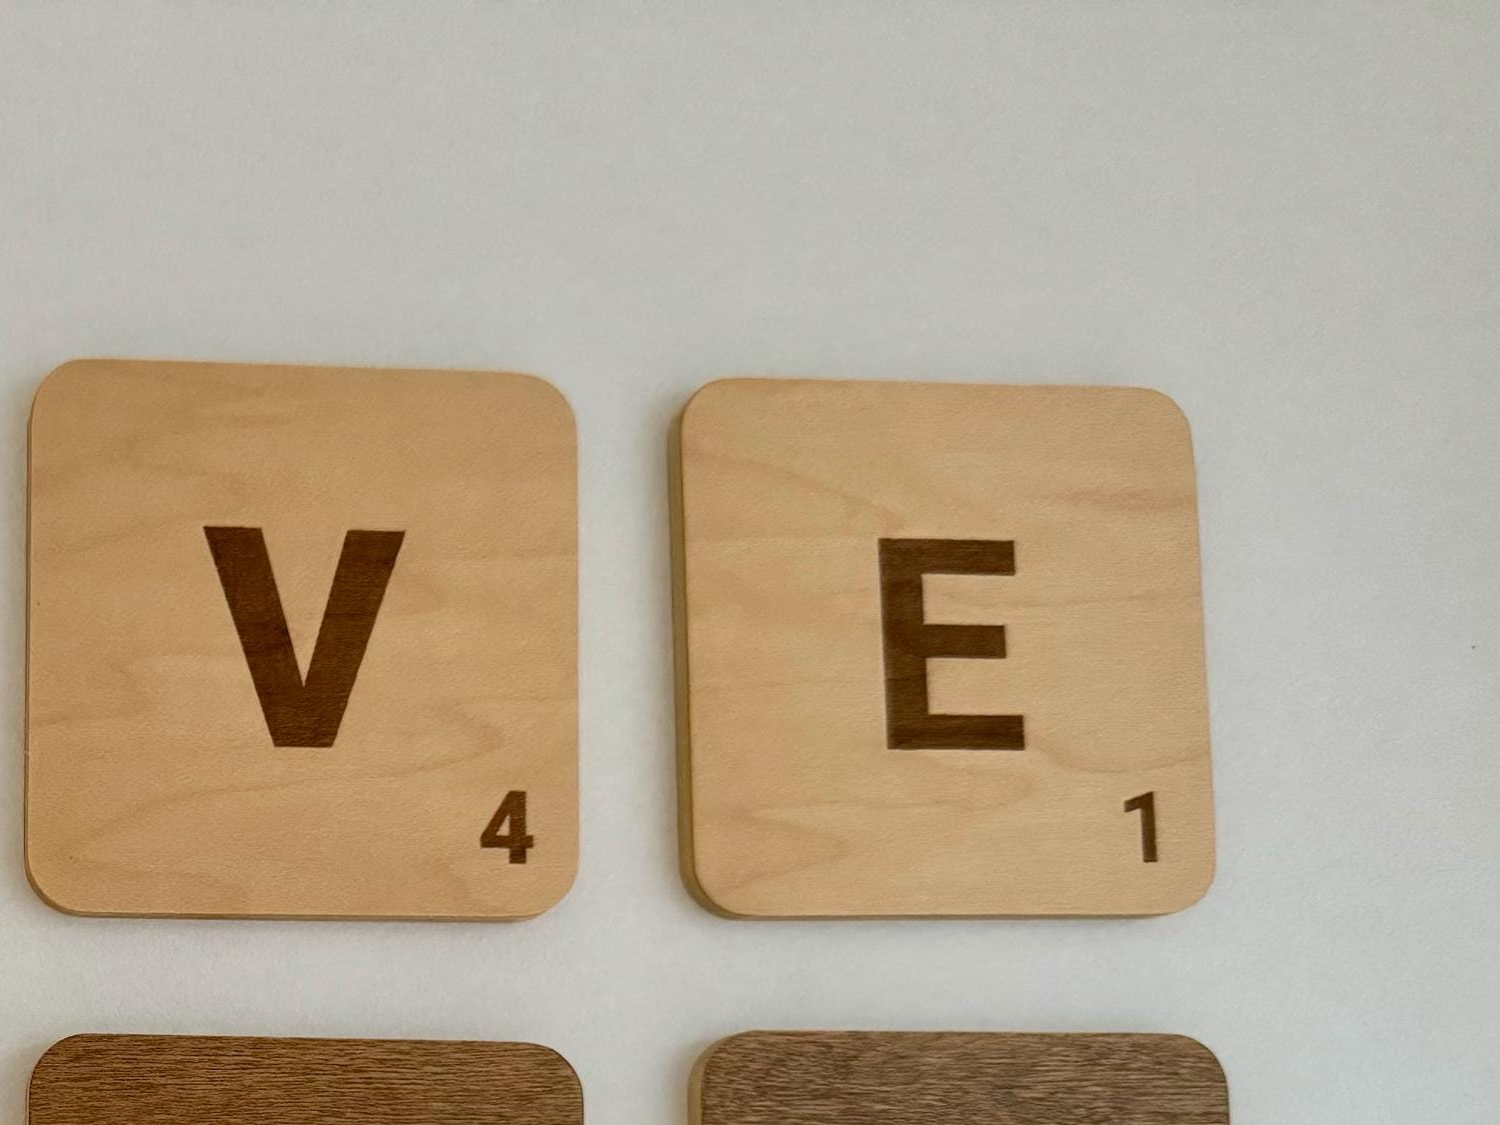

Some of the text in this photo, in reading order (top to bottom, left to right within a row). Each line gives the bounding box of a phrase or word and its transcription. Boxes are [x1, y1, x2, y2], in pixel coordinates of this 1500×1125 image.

[204, 526, 405, 748] V
[879, 538, 1025, 750] E
[479, 790, 536, 865] 4
[1124, 791, 1159, 864] 1
